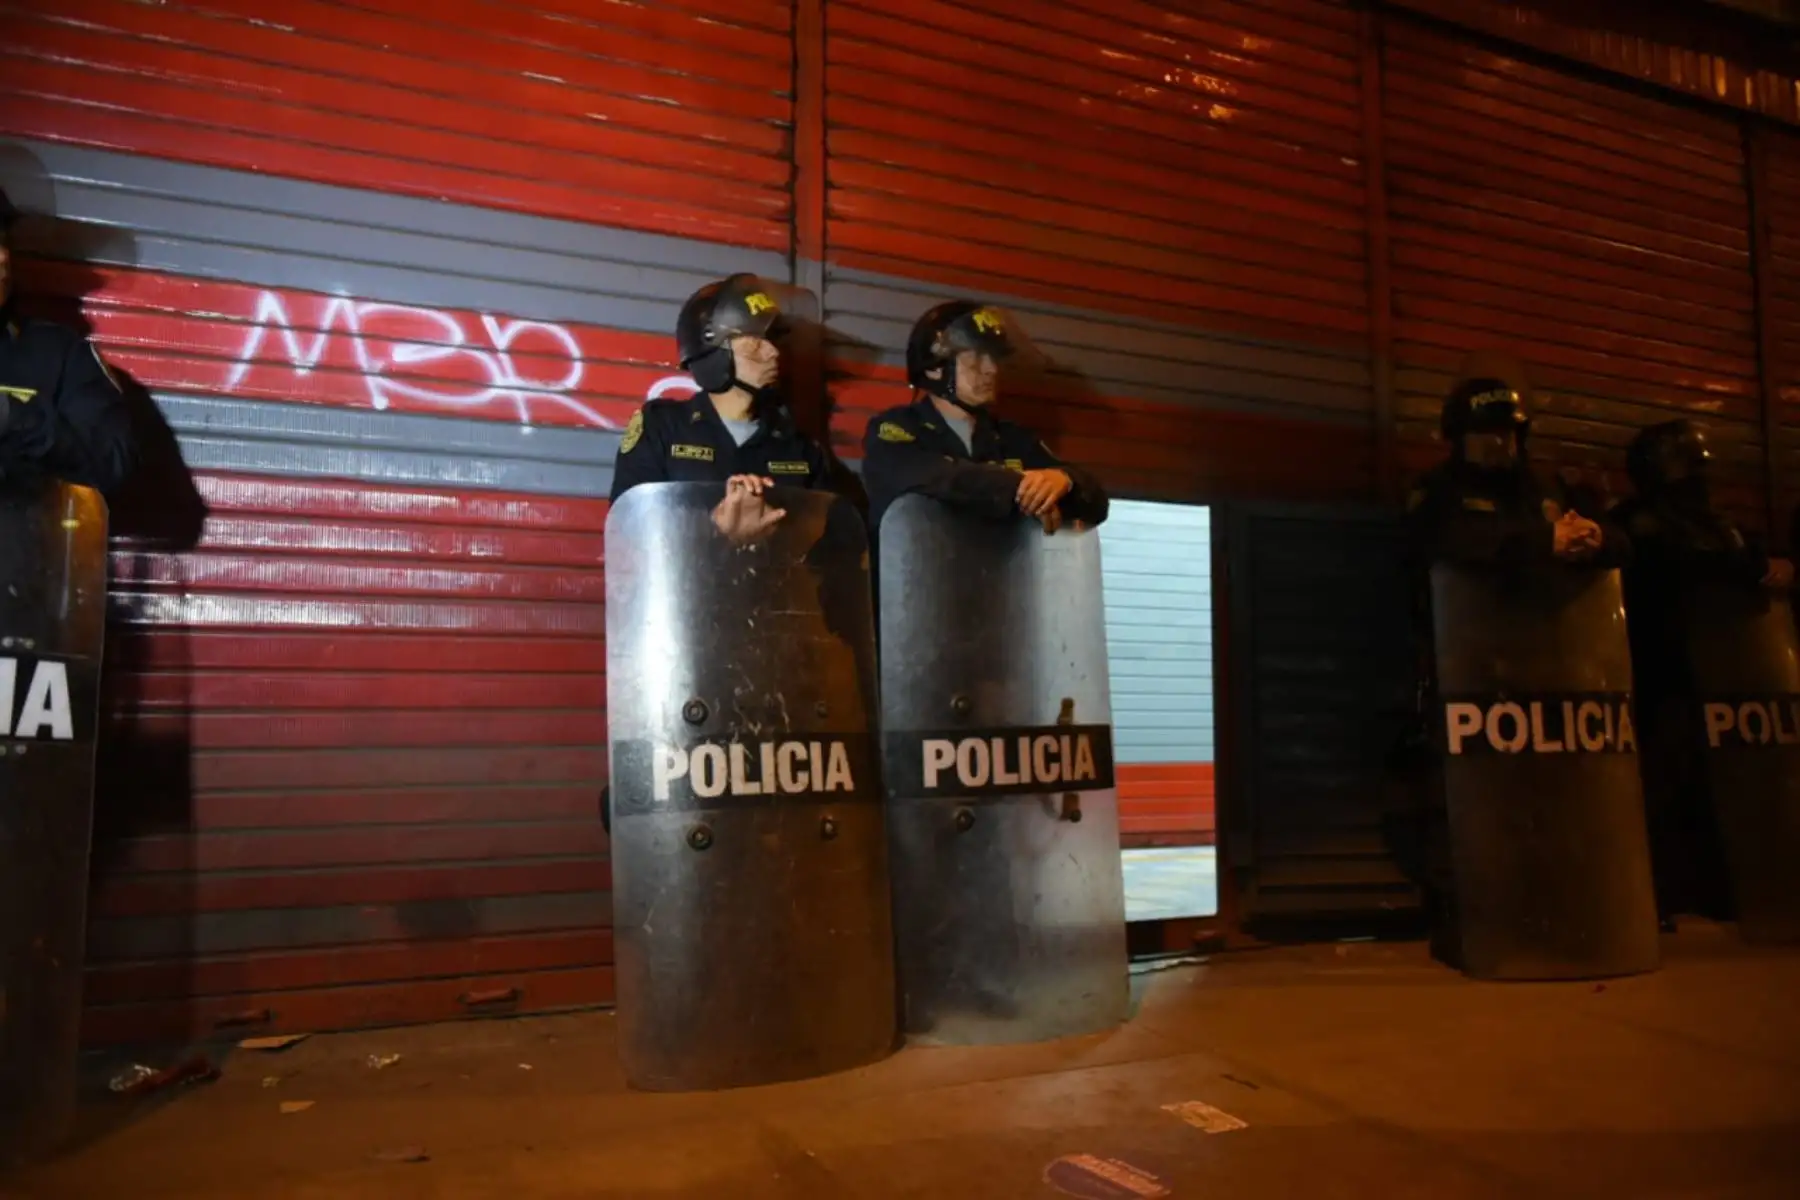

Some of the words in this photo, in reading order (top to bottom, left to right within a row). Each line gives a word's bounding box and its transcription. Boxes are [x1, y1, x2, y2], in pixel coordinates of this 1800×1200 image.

[1445, 699, 1636, 755] POLICIA
[652, 739, 854, 802] POLICIA
[922, 734, 1096, 788] POLICIA
